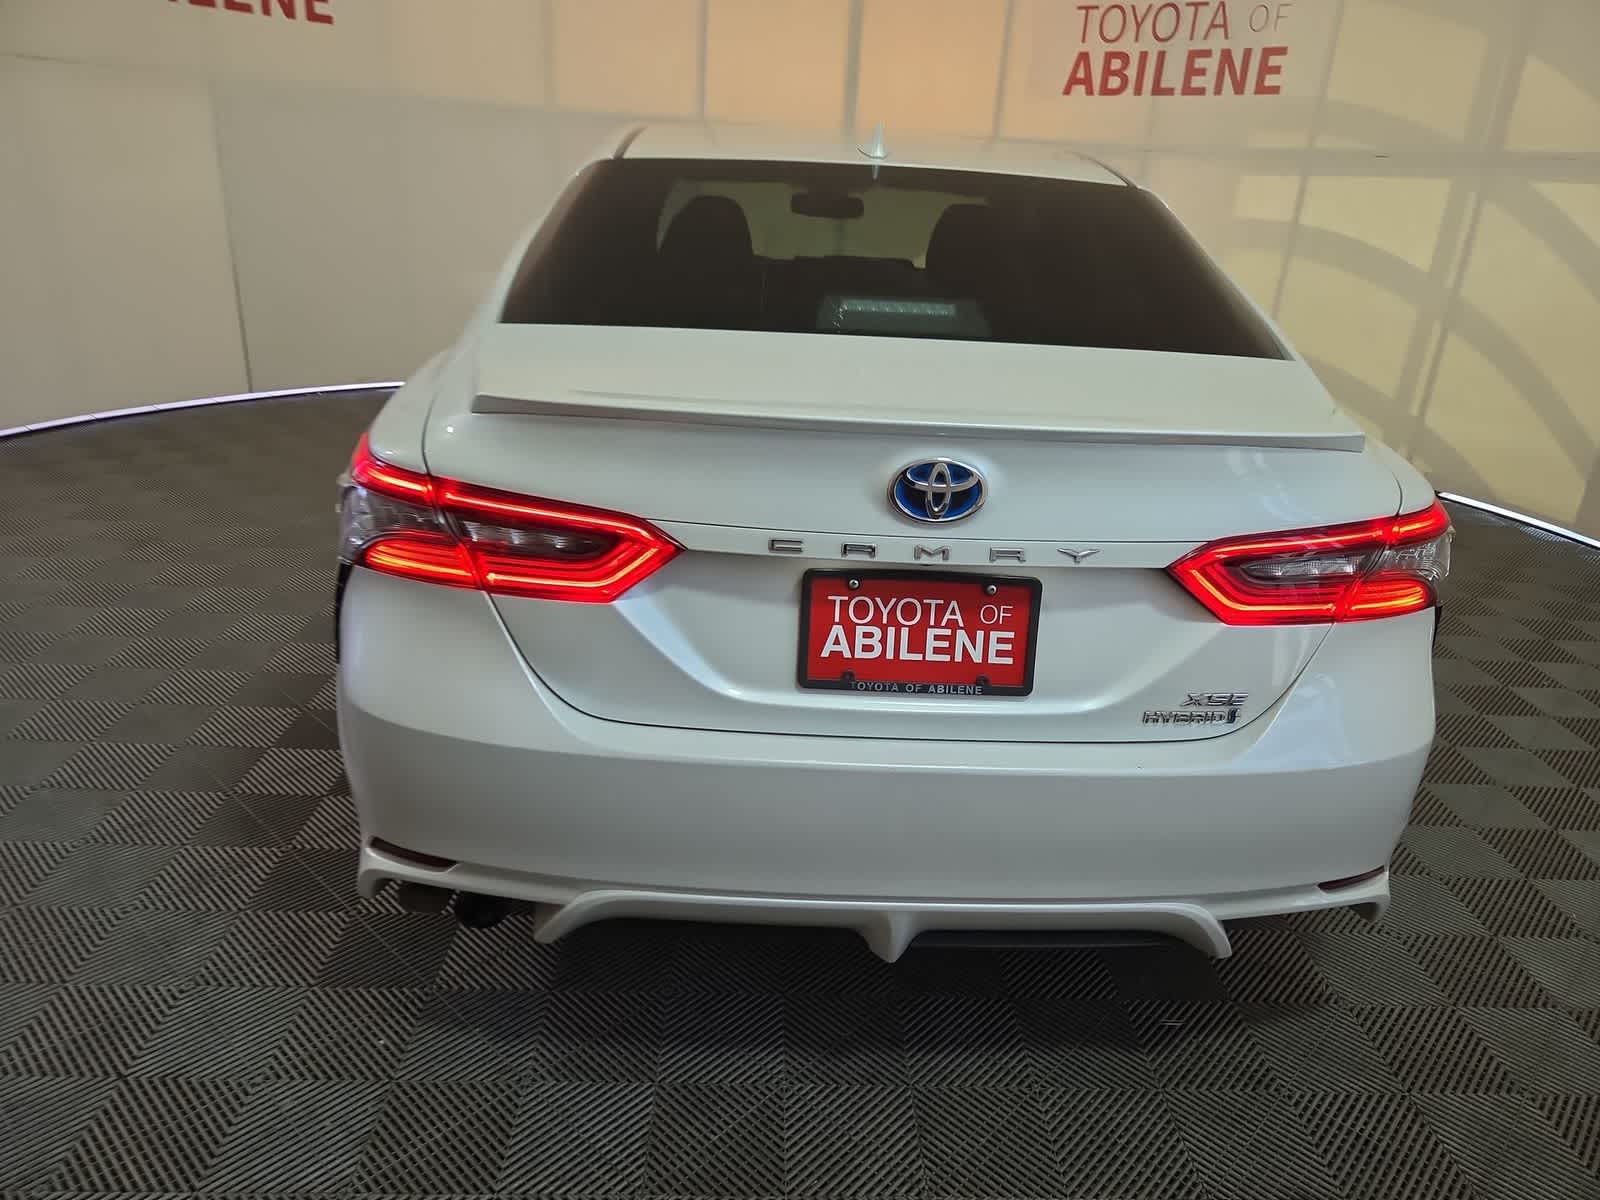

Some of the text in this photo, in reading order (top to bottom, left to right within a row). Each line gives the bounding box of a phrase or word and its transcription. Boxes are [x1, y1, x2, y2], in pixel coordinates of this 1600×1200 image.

[1077, 1, 1293, 43] TOYOTA OF
[1062, 46, 1288, 97] ABILENE
[768, 538, 1101, 564] CAMRY
[827, 595, 1013, 628] TOYOTA OF
[820, 624, 1015, 665] ABILENE
[850, 682, 983, 695] TOYOTA OF ABILENE
[1181, 693, 1248, 706] XSE
[1142, 711, 1226, 724] HYBRID
